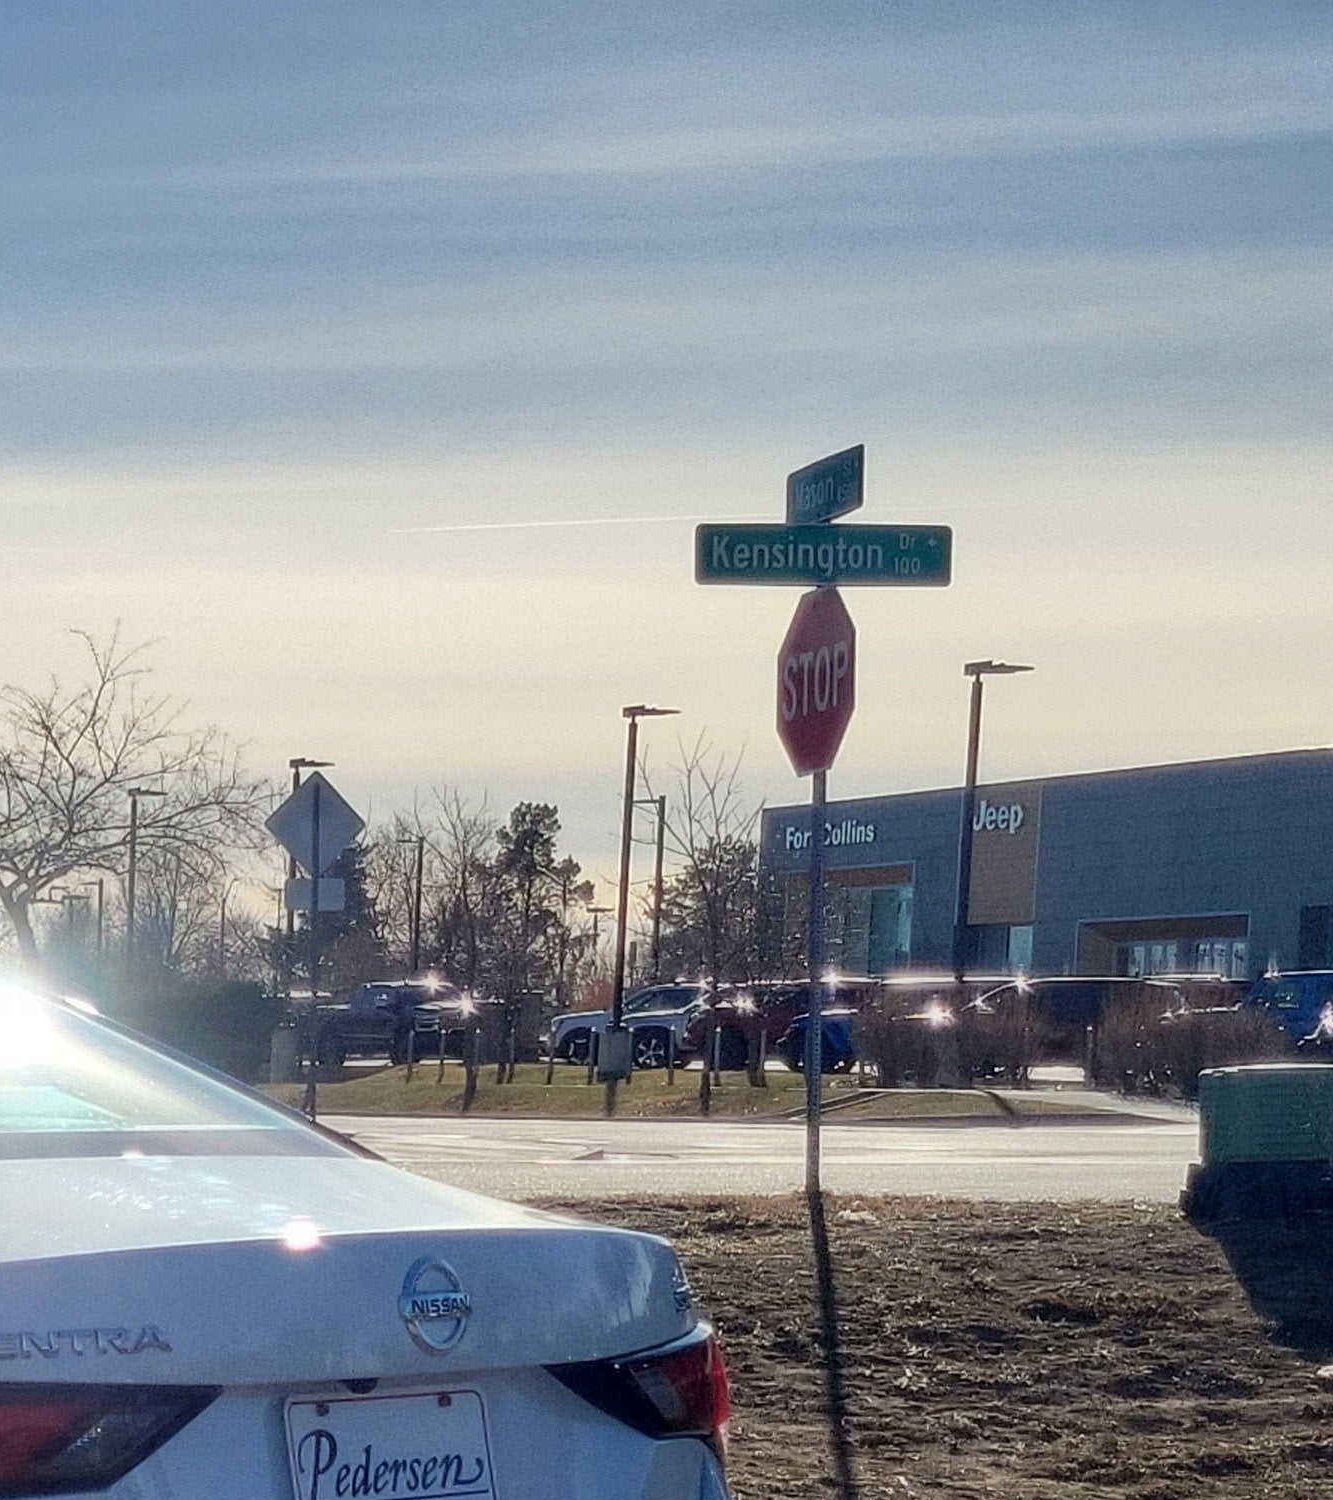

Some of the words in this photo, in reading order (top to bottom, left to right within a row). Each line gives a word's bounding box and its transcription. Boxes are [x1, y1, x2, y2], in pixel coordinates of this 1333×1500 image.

[712, 534, 883, 577] Kensington
[899, 532, 916, 551] Dr
[894, 556, 921, 575] 100
[781, 641, 848, 721] STOP
[973, 800, 1024, 835] Jeep
[786, 826, 813, 849] For
[411, 1294, 470, 1315] NISSAN
